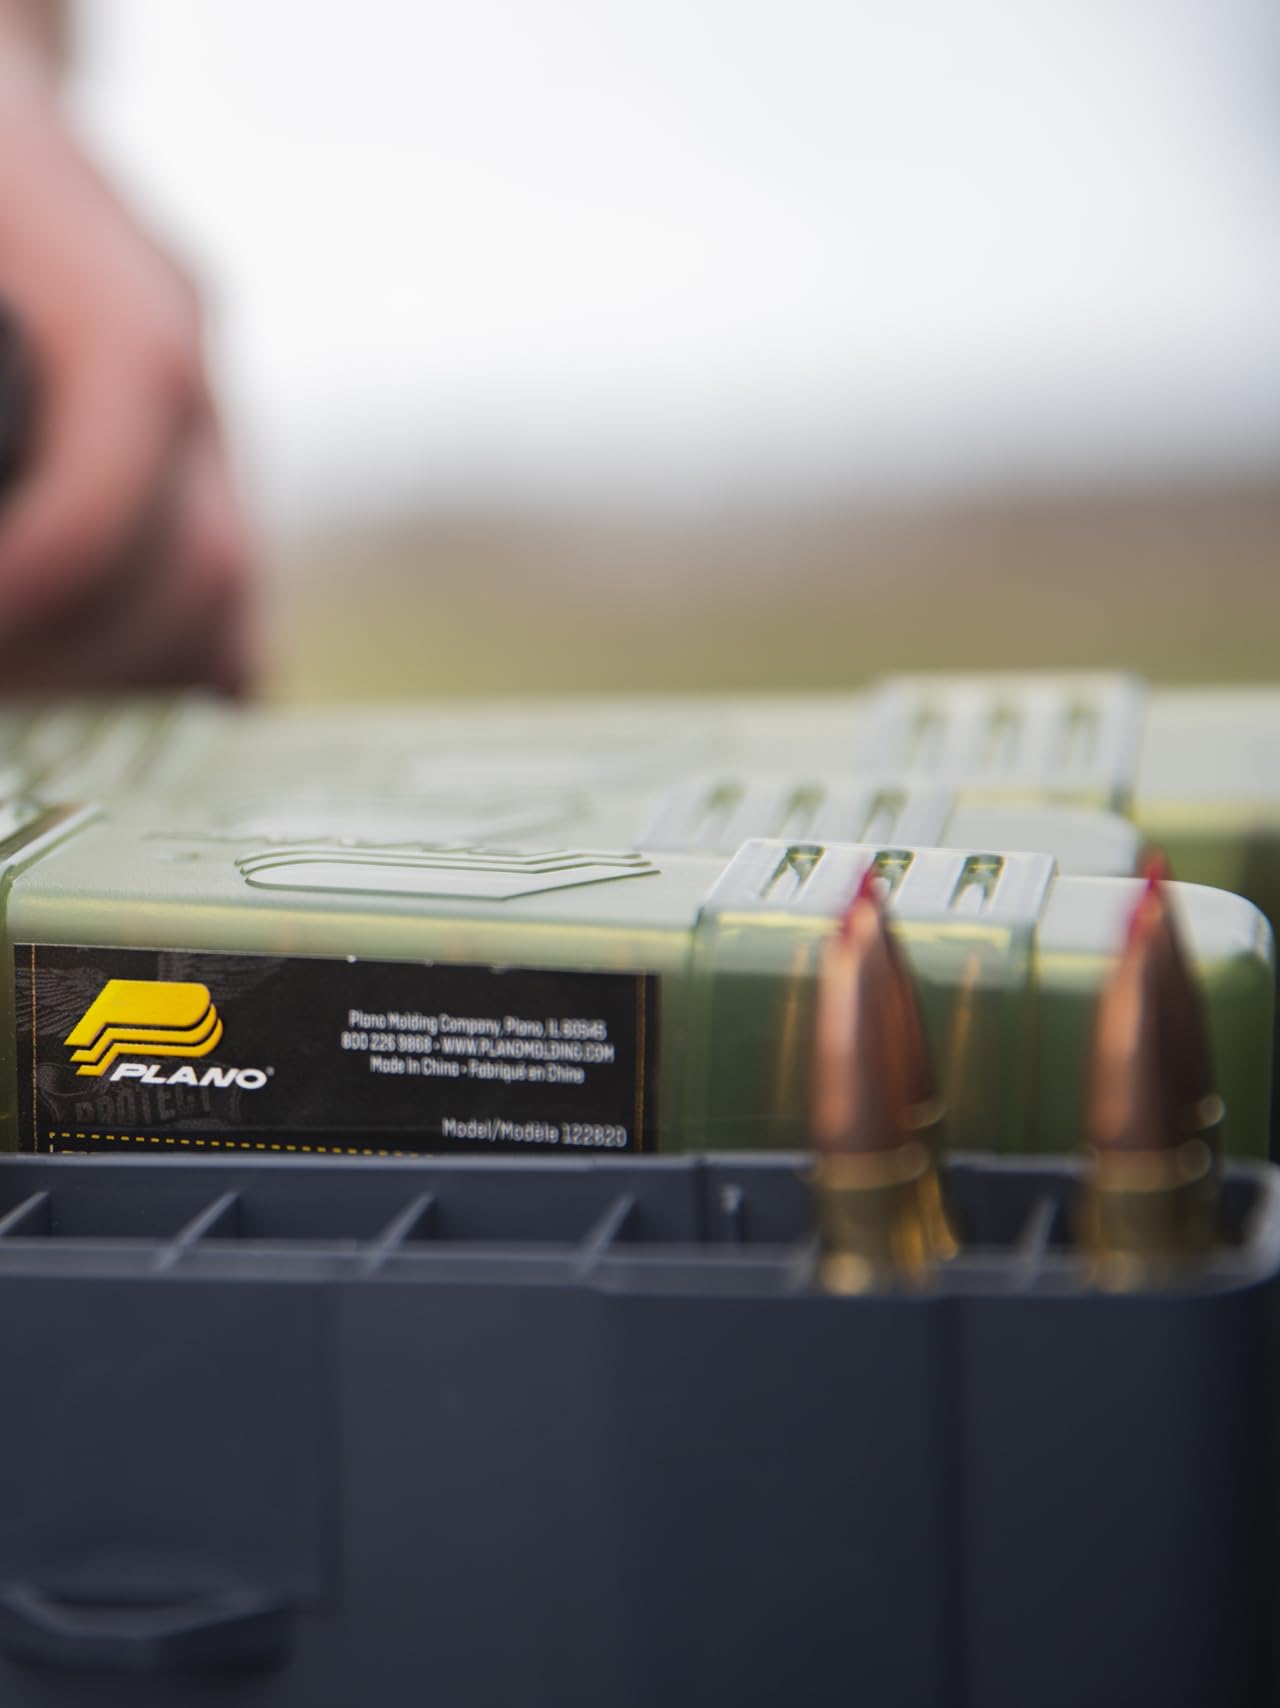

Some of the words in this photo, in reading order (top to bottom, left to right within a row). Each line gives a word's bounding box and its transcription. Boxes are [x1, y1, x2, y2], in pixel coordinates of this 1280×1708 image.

[348, 1009, 387, 1029] Plano
[387, 1011, 438, 1035] Molding
[341, 1031, 369, 1050] 800
[369, 1033, 396, 1052] 226
[110, 1062, 268, 1090] PLANO
[370, 1055, 406, 1075] Made
[421, 1057, 460, 1078] China
[527, 1065, 545, 1082] en
[442, 1117, 560, 1144] Model/Modèle
